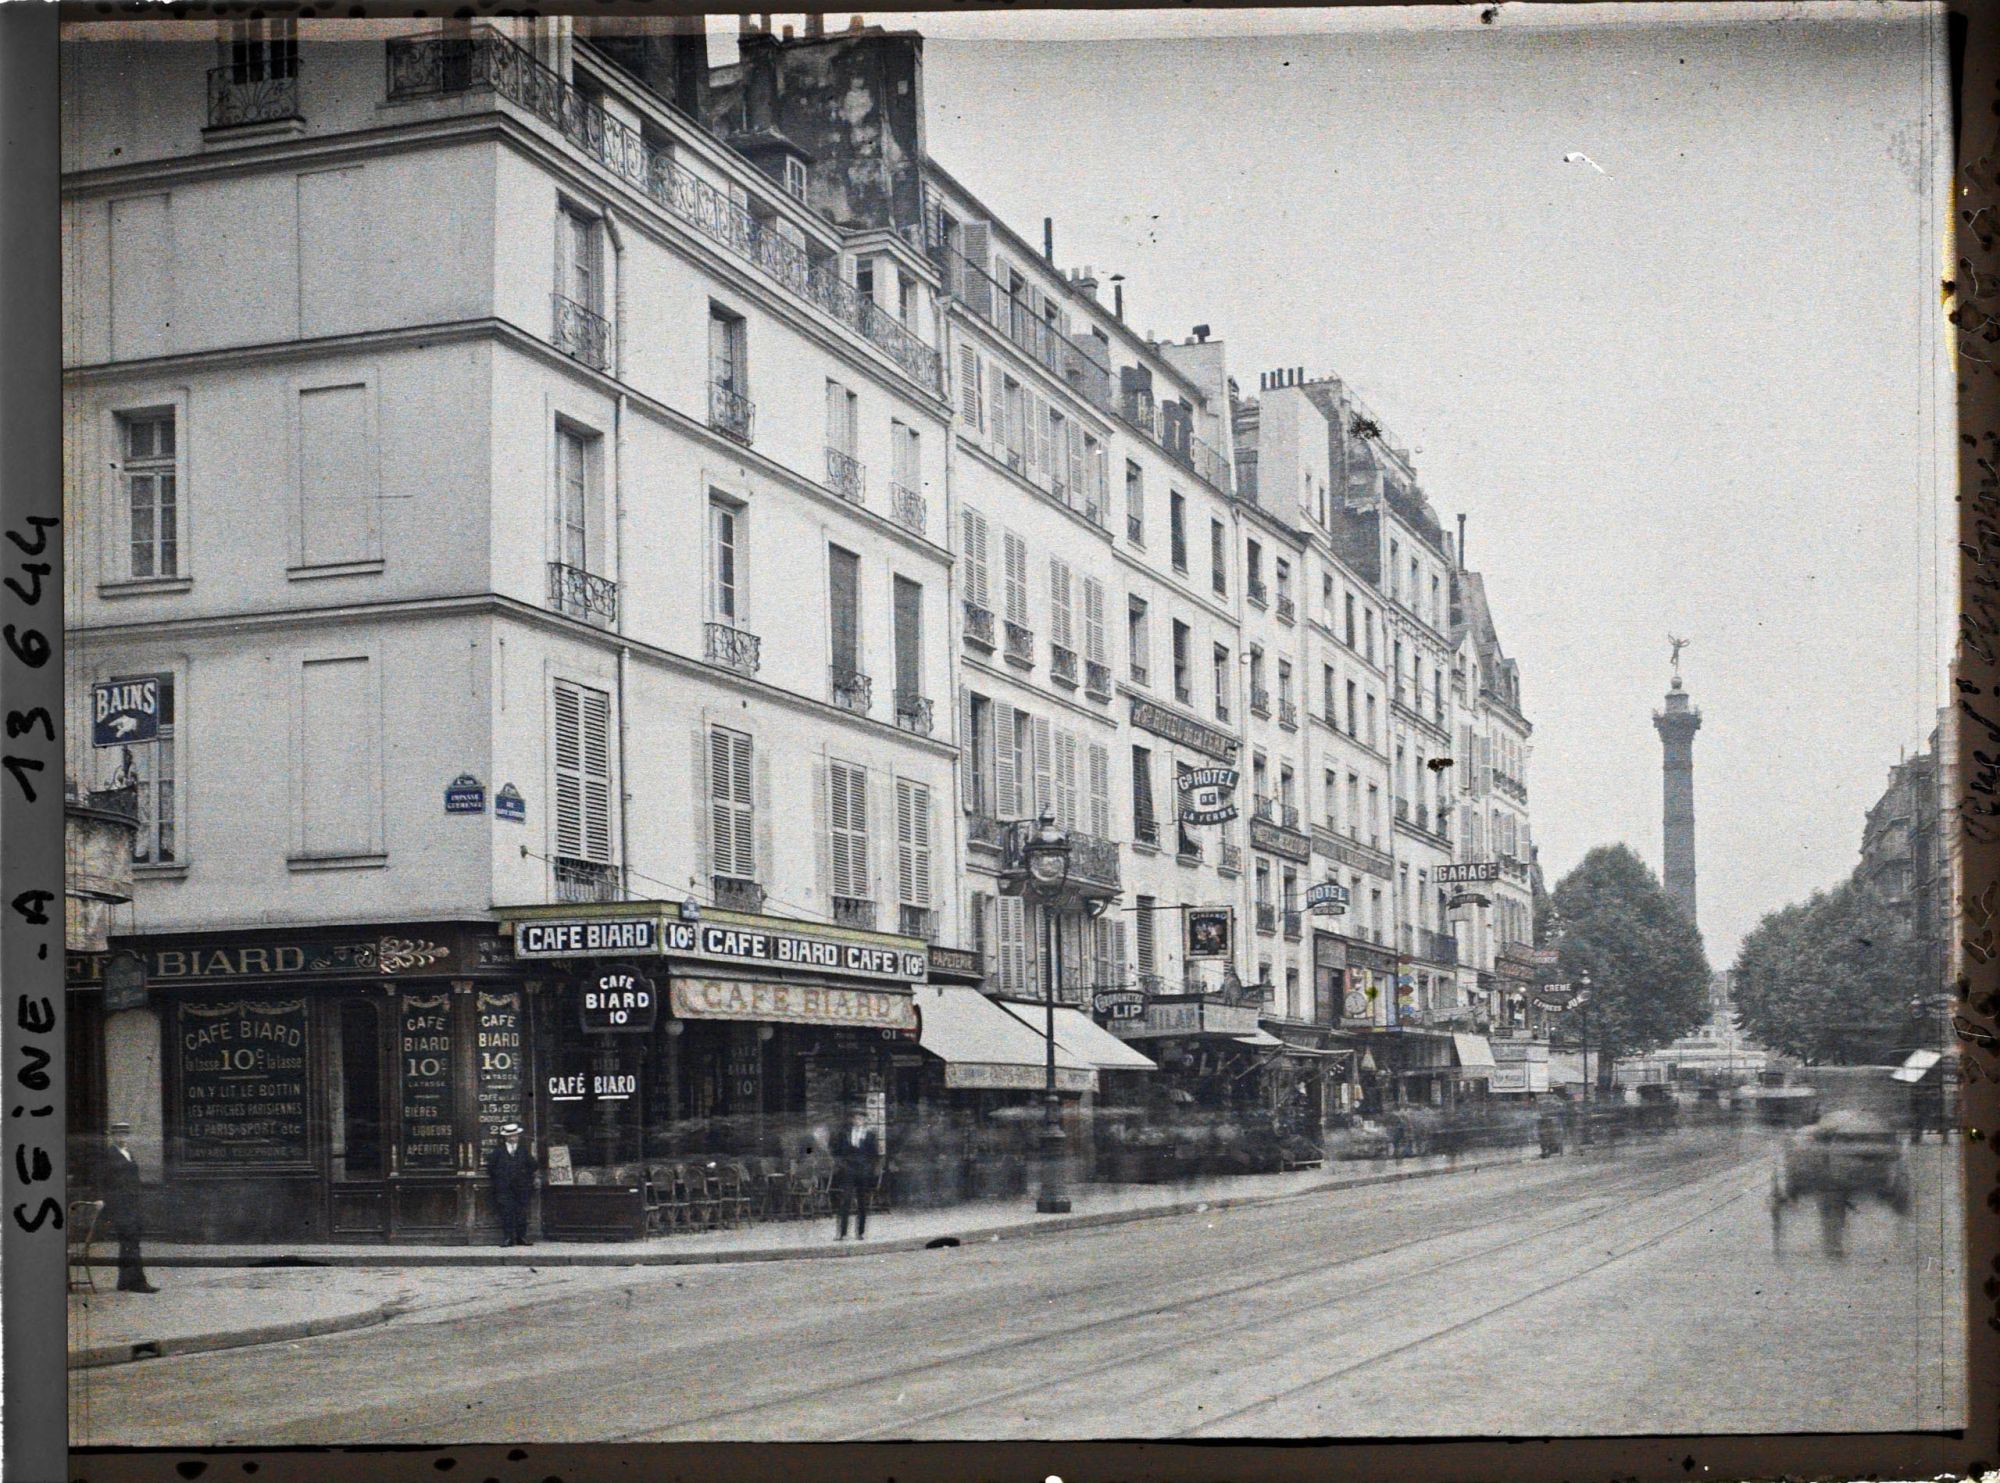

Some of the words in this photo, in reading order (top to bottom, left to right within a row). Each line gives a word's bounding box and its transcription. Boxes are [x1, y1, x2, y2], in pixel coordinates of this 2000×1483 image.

[96, 681, 156, 723] BAINS
[1193, 769, 1234, 787] HOTEL
[1202, 794, 1215, 803] DE
[1182, 811, 1194, 821] LA
[1438, 864, 1497, 881] GARAGE
[1307, 885, 1346, 902] HOTEL
[528, 925, 582, 950] CAFE
[587, 923, 648, 948] BIARD
[707, 930, 765, 958] CAFE
[777, 938, 838, 966] BIARD
[847, 947, 895, 973] CAFE
[157, 946, 304, 976] BIARD
[599, 975, 635, 990] CAFE
[585, 992, 649, 1009] BIARD
[702, 981, 789, 1013] CAFE
[804, 987, 890, 1018] BIARD
[1113, 1004, 1142, 1018] LIP
[407, 1016, 446, 1031] CAFE
[481, 1014, 516, 1028] CAFE
[240, 1020, 301, 1047] BIARD
[478, 1032, 519, 1047] BIARD
[403, 1036, 449, 1052] BIARD
[188, 1086, 205, 1098] ON
[207, 1085, 216, 1098] Y
[220, 1084, 236, 1098] LIT
[241, 1084, 254, 1098] LE
[258, 1083, 301, 1097] BOTTIN
[548, 1072, 586, 1094] CAFÉ
[594, 1075, 636, 1094] BIARD
